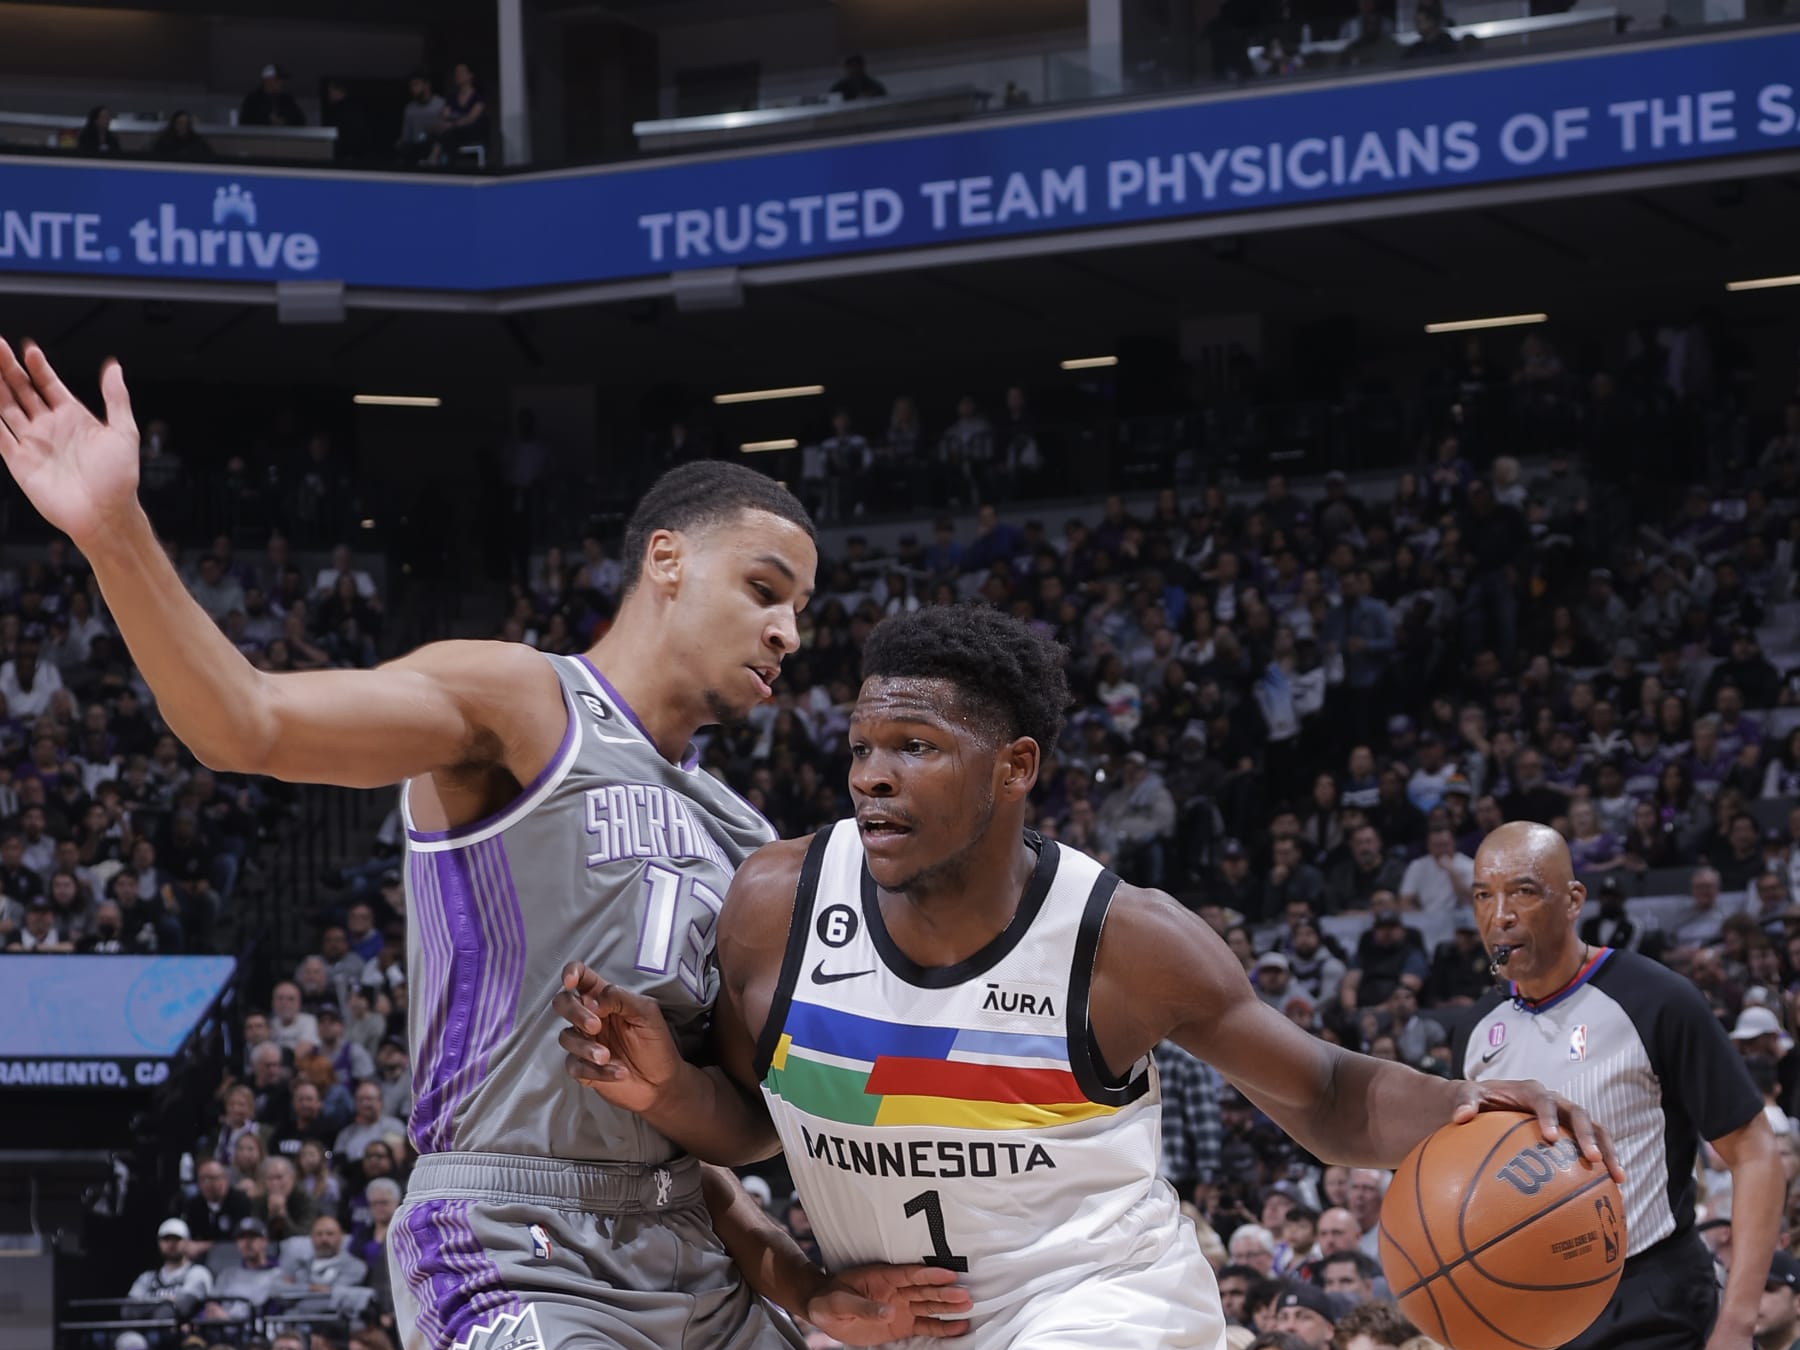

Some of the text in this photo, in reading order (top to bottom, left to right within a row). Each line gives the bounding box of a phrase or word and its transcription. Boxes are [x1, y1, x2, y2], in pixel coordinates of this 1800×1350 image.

[639, 84, 1800, 260] TRUSTED TEAM PHYSICIANS OF THE S
[0, 203, 320, 271] NTE thrive
[826, 910, 850, 943] 6
[801, 1124, 1058, 1178] MINNESOTA
[903, 1189, 969, 1274] 1
